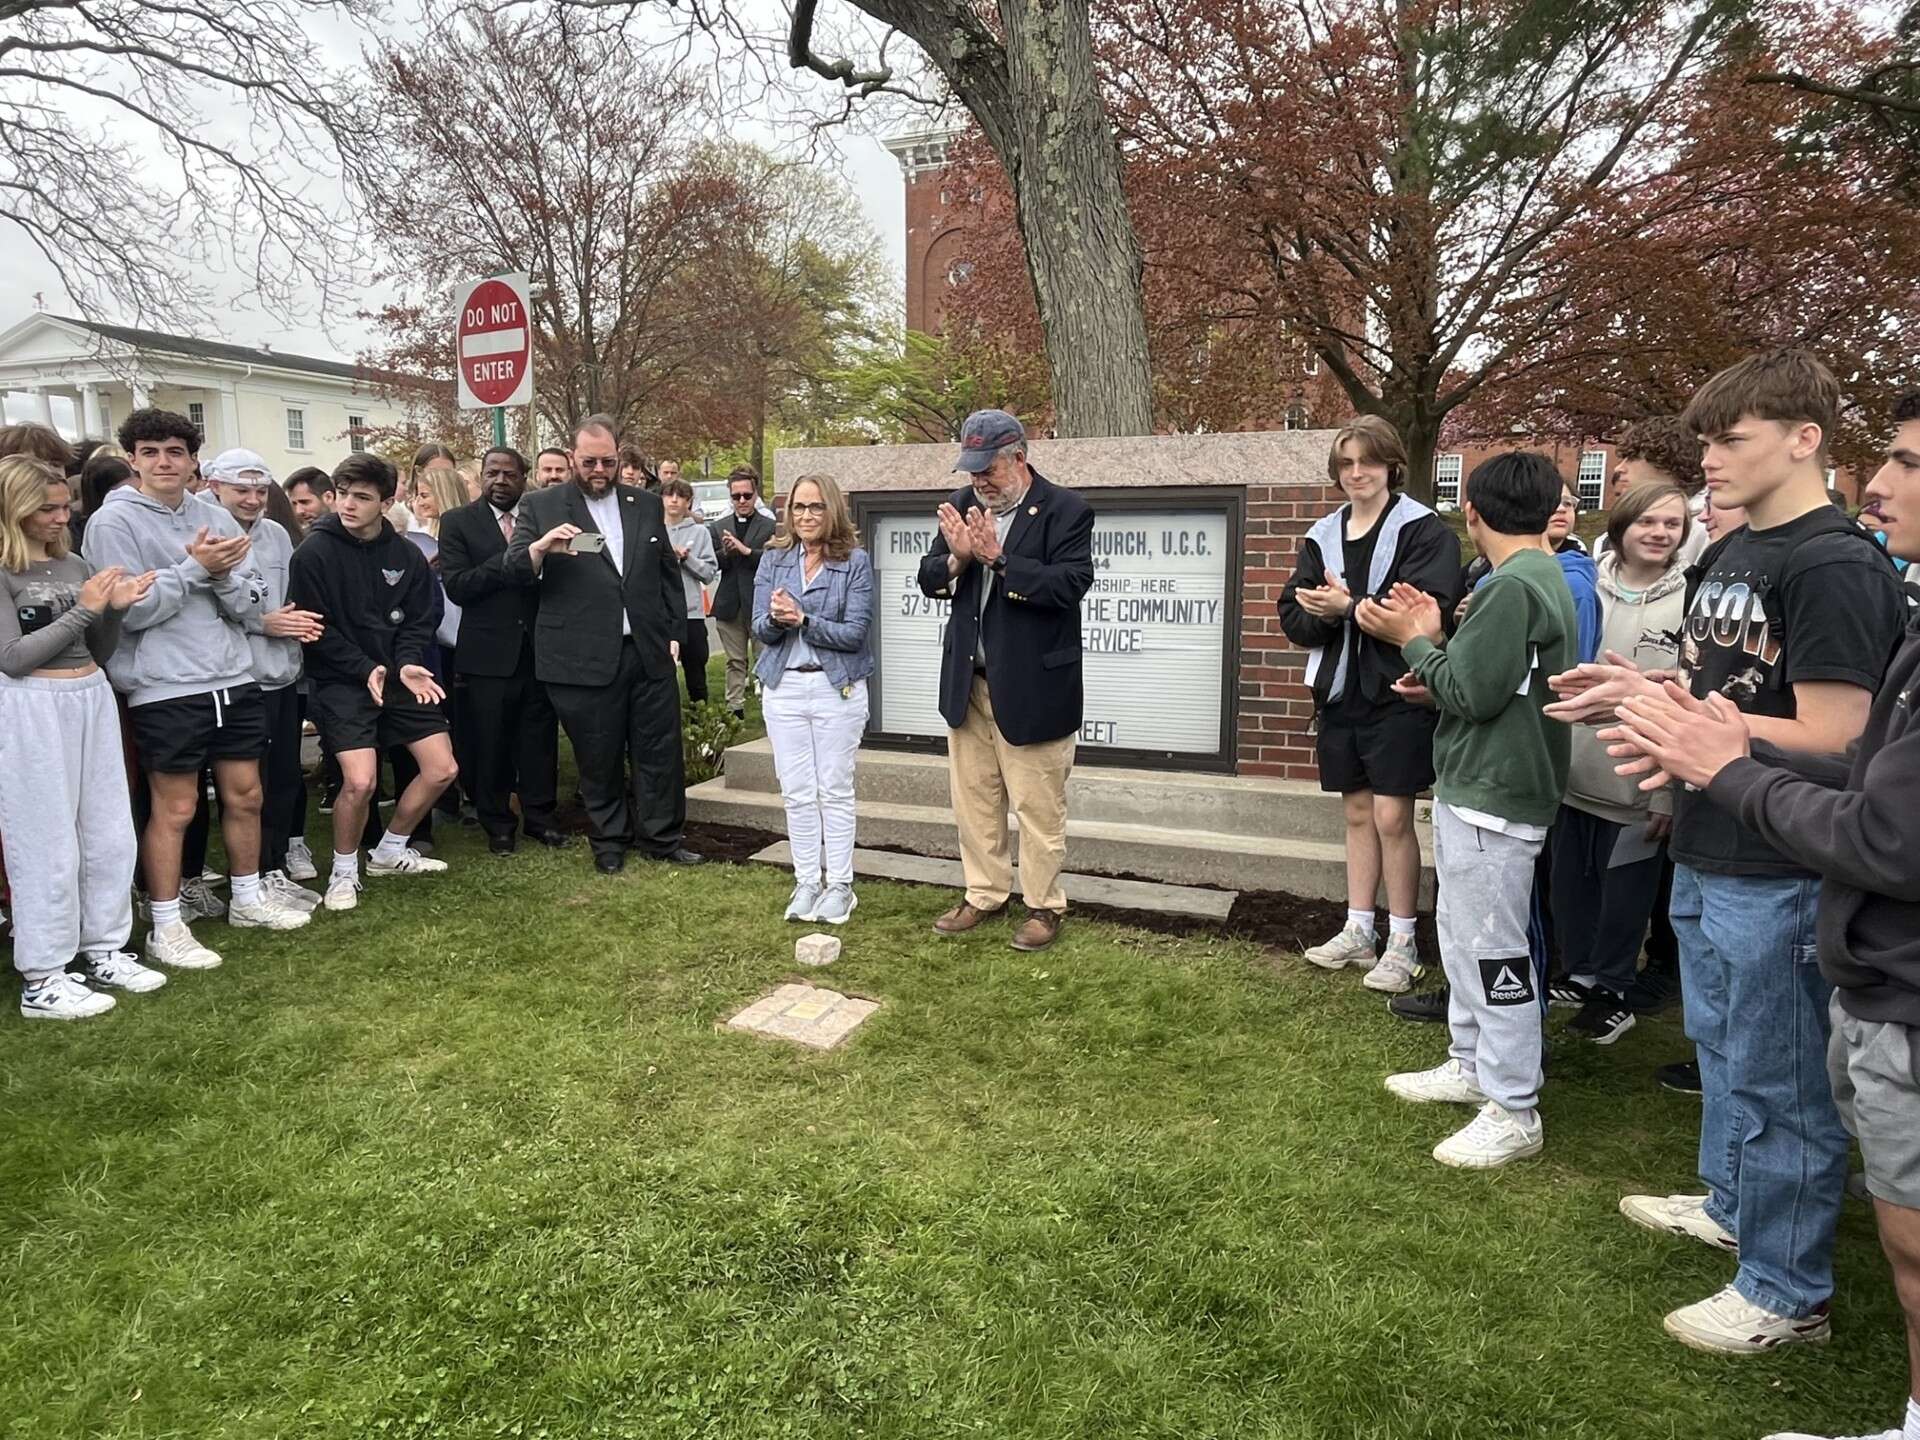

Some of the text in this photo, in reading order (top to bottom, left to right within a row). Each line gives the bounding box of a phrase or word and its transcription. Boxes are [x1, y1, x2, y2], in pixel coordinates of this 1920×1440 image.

[467, 302, 517, 327] DO NOT
[473, 360, 514, 382] ENTER
[890, 530, 1212, 560] FIRST HURCH, U.C.C.
[1089, 578, 1177, 593] RSHIP HERE
[901, 594, 931, 616] 379
[1117, 599, 1218, 625] COMMUNITY
[1682, 581, 1781, 667] SON
[1081, 627, 1142, 653] ERVICE
[1490, 988, 1529, 1000] Reebok
